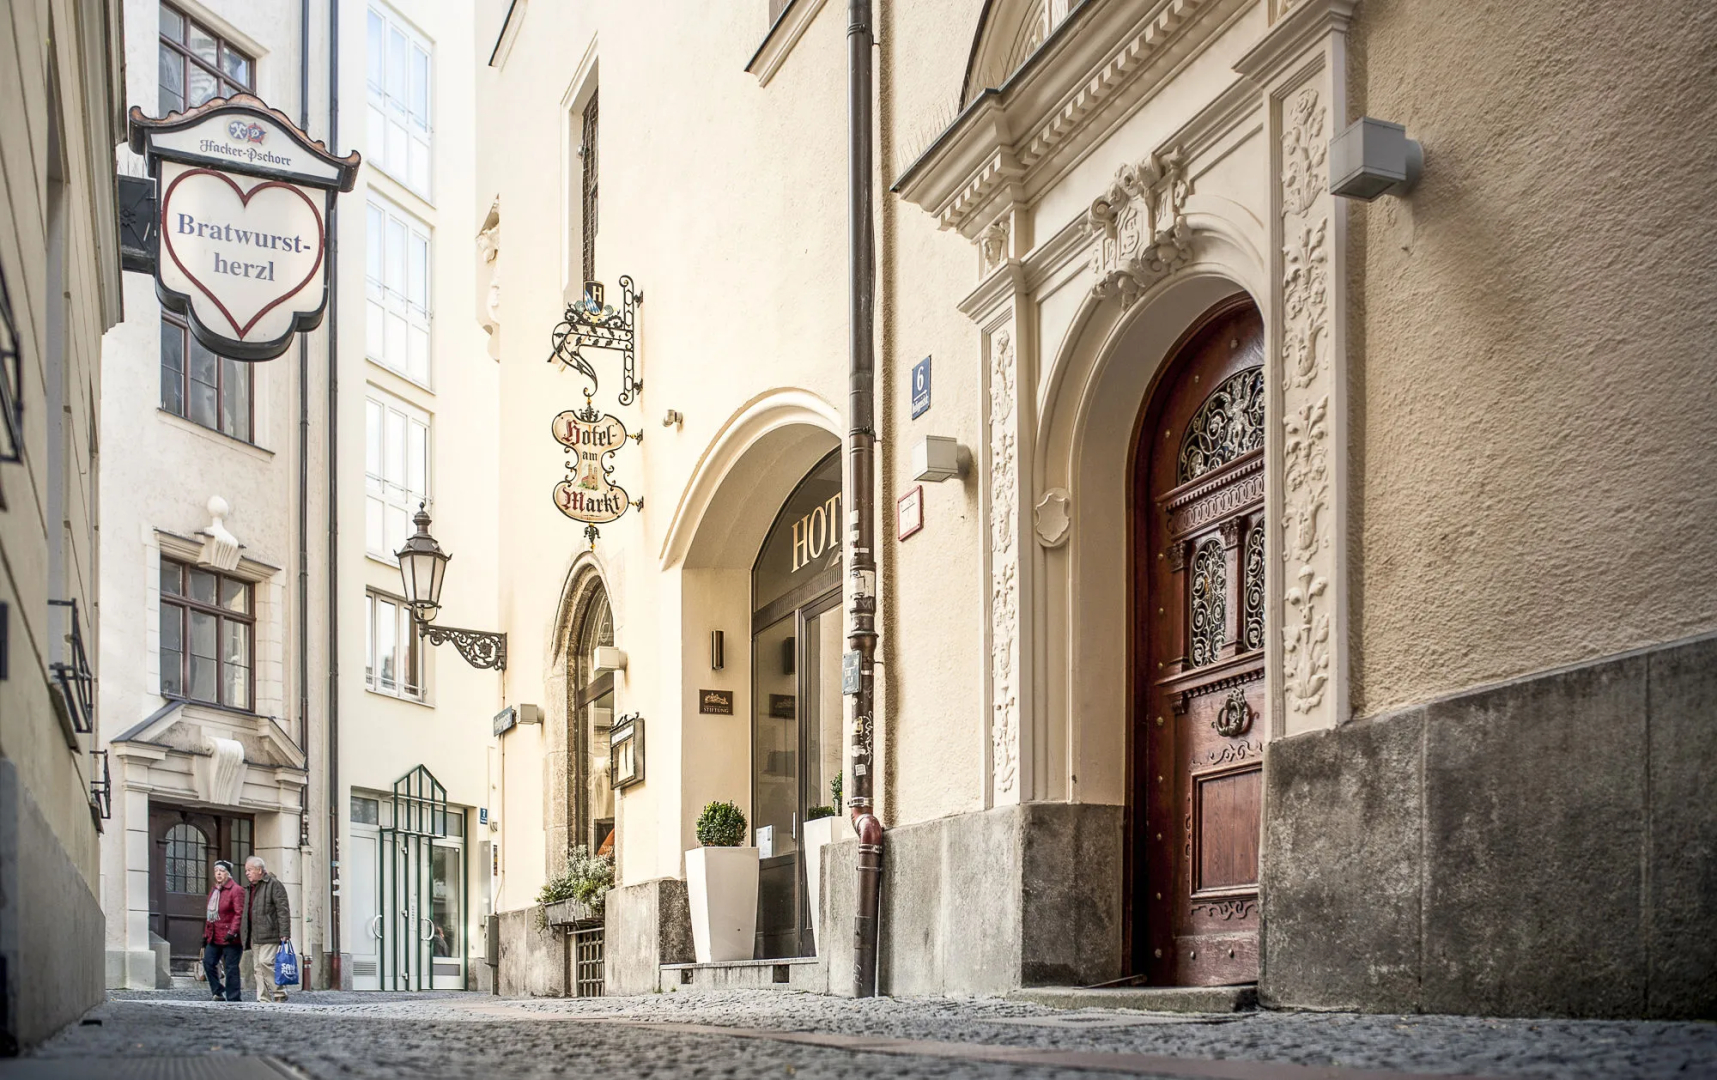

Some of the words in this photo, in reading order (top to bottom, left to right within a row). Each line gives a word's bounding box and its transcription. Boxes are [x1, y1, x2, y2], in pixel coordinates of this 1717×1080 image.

[200, 139, 291, 166] Hacker-Pschorr
[177, 212, 311, 253] Bratwurst-
[213, 251, 275, 282] herzl
[592, 285, 602, 302] H
[916, 365, 924, 391] 6
[582, 450, 598, 461] am
[561, 486, 621, 515] Markt
[791, 491, 842, 574] HOT
